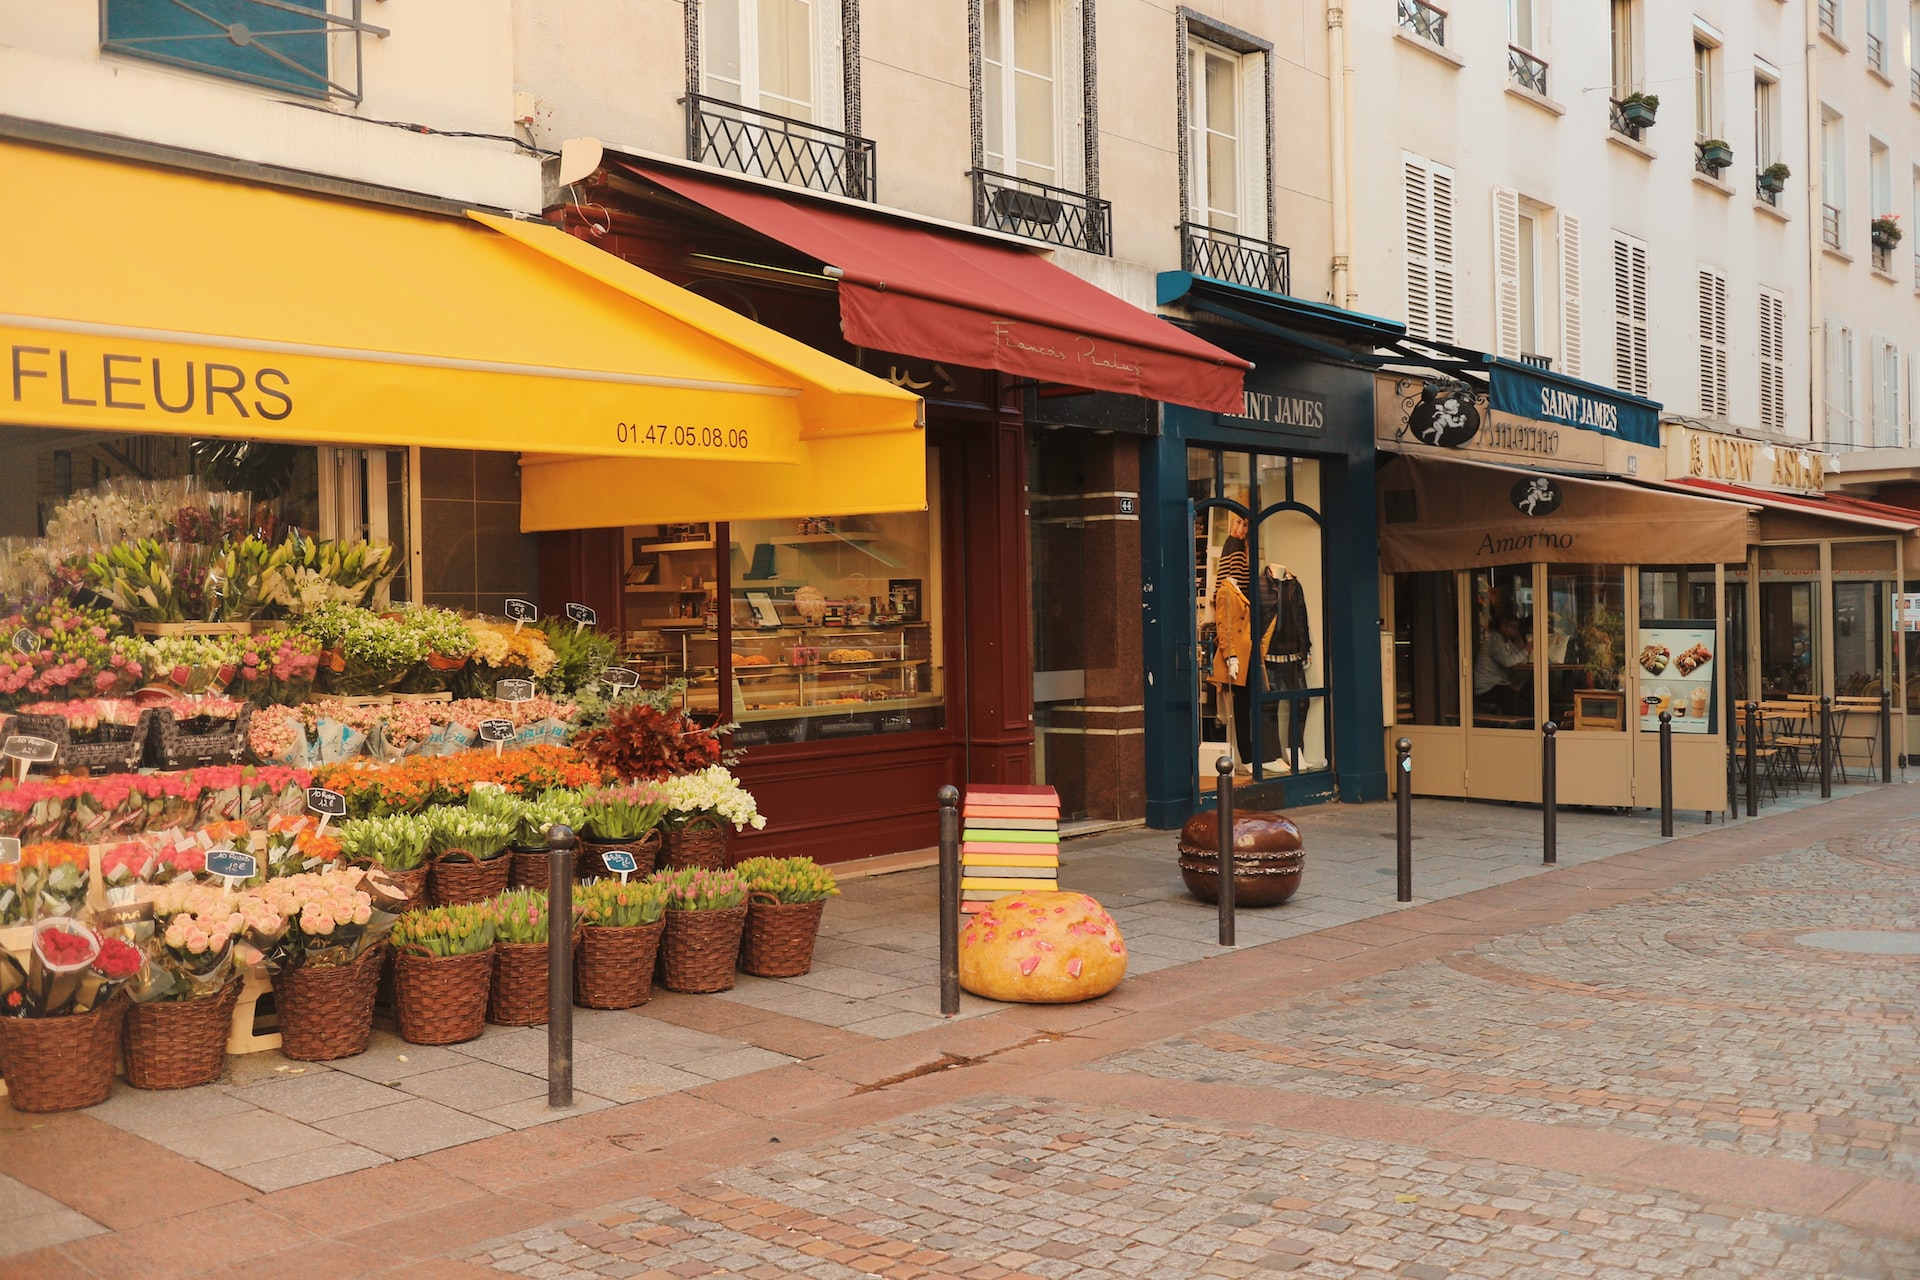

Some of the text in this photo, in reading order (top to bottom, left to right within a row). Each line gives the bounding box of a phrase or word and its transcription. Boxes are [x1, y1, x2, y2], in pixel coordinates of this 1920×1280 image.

[11, 344, 294, 421] FLEURS
[1223, 390, 1324, 429] INT JAMES
[1541, 386, 1618, 432] SAINT JAMES
[616, 422, 749, 449] 01.47.05.08.06
[1708, 436, 1755, 482] NEW
[1122, 500, 1132, 511] 44
[1476, 527, 1574, 556] Amorino
